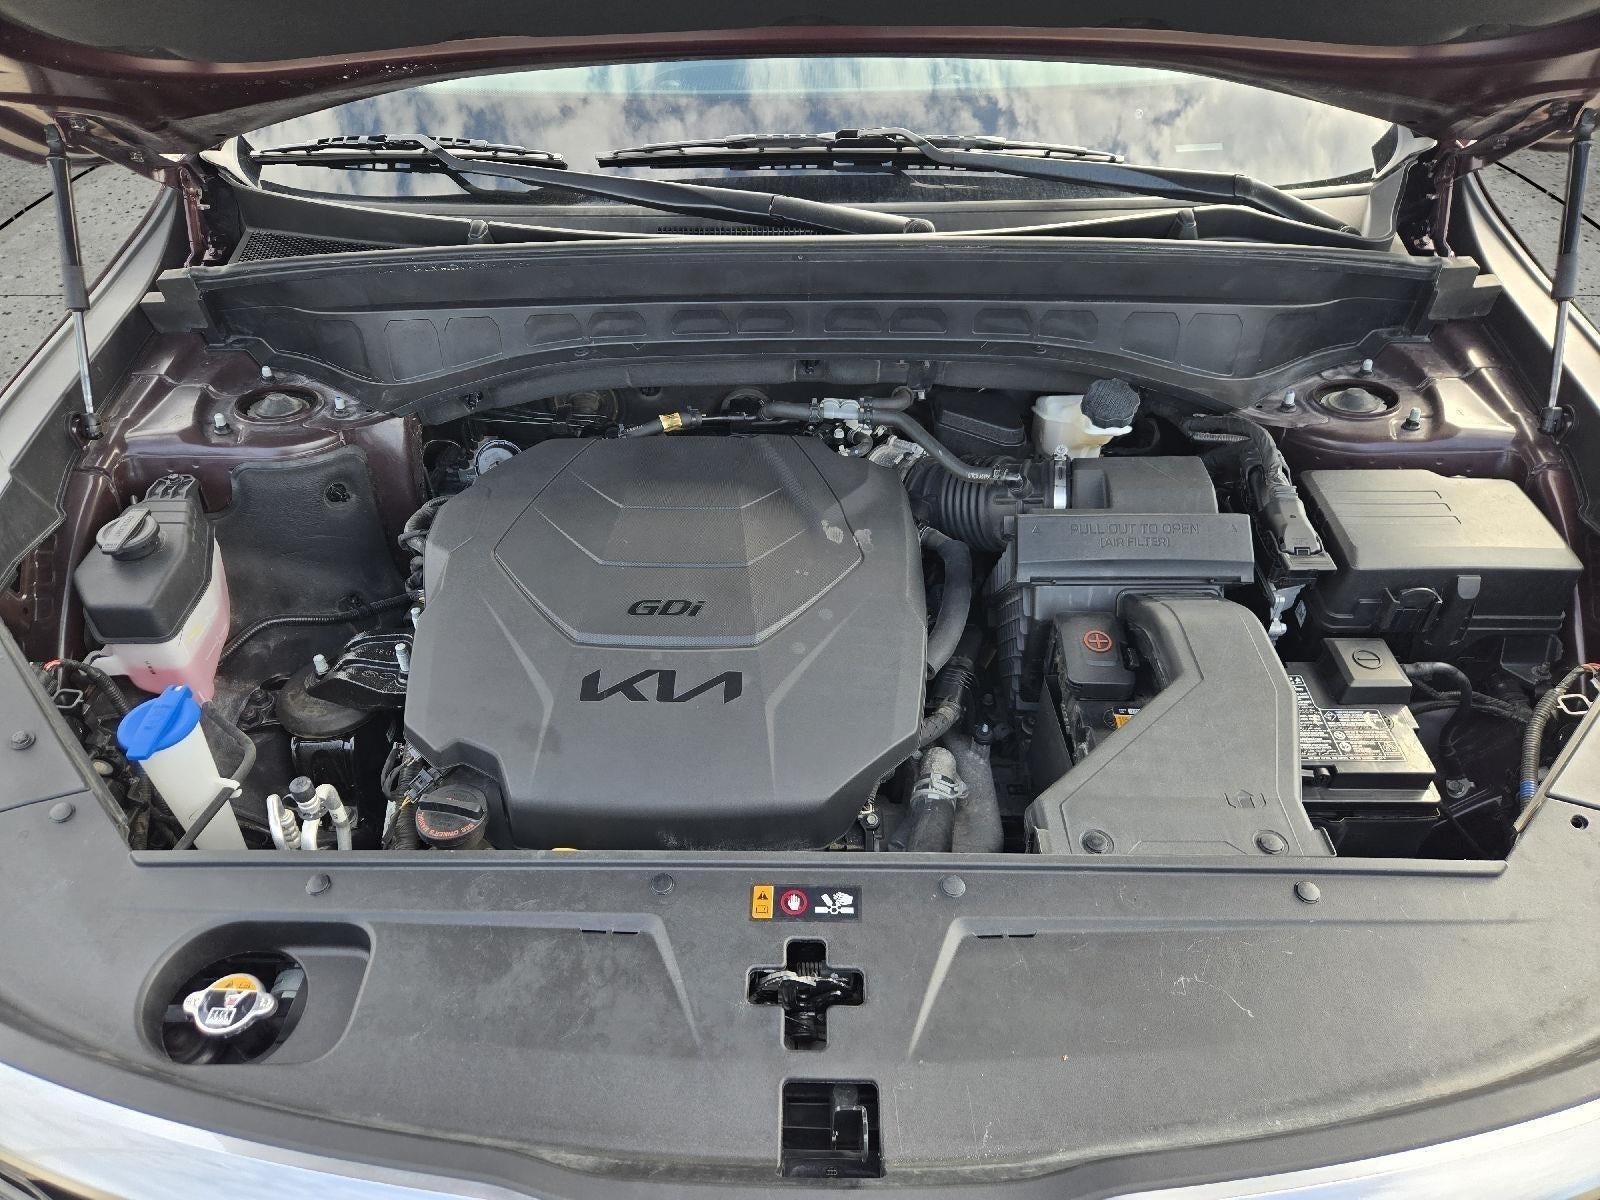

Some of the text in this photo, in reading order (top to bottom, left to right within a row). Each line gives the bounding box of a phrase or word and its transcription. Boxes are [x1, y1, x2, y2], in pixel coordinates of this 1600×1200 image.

[1070, 523, 1200, 536] PULL OUT TO OPEN
[627, 599, 707, 617] GDi
[580, 669, 743, 705] KIA
